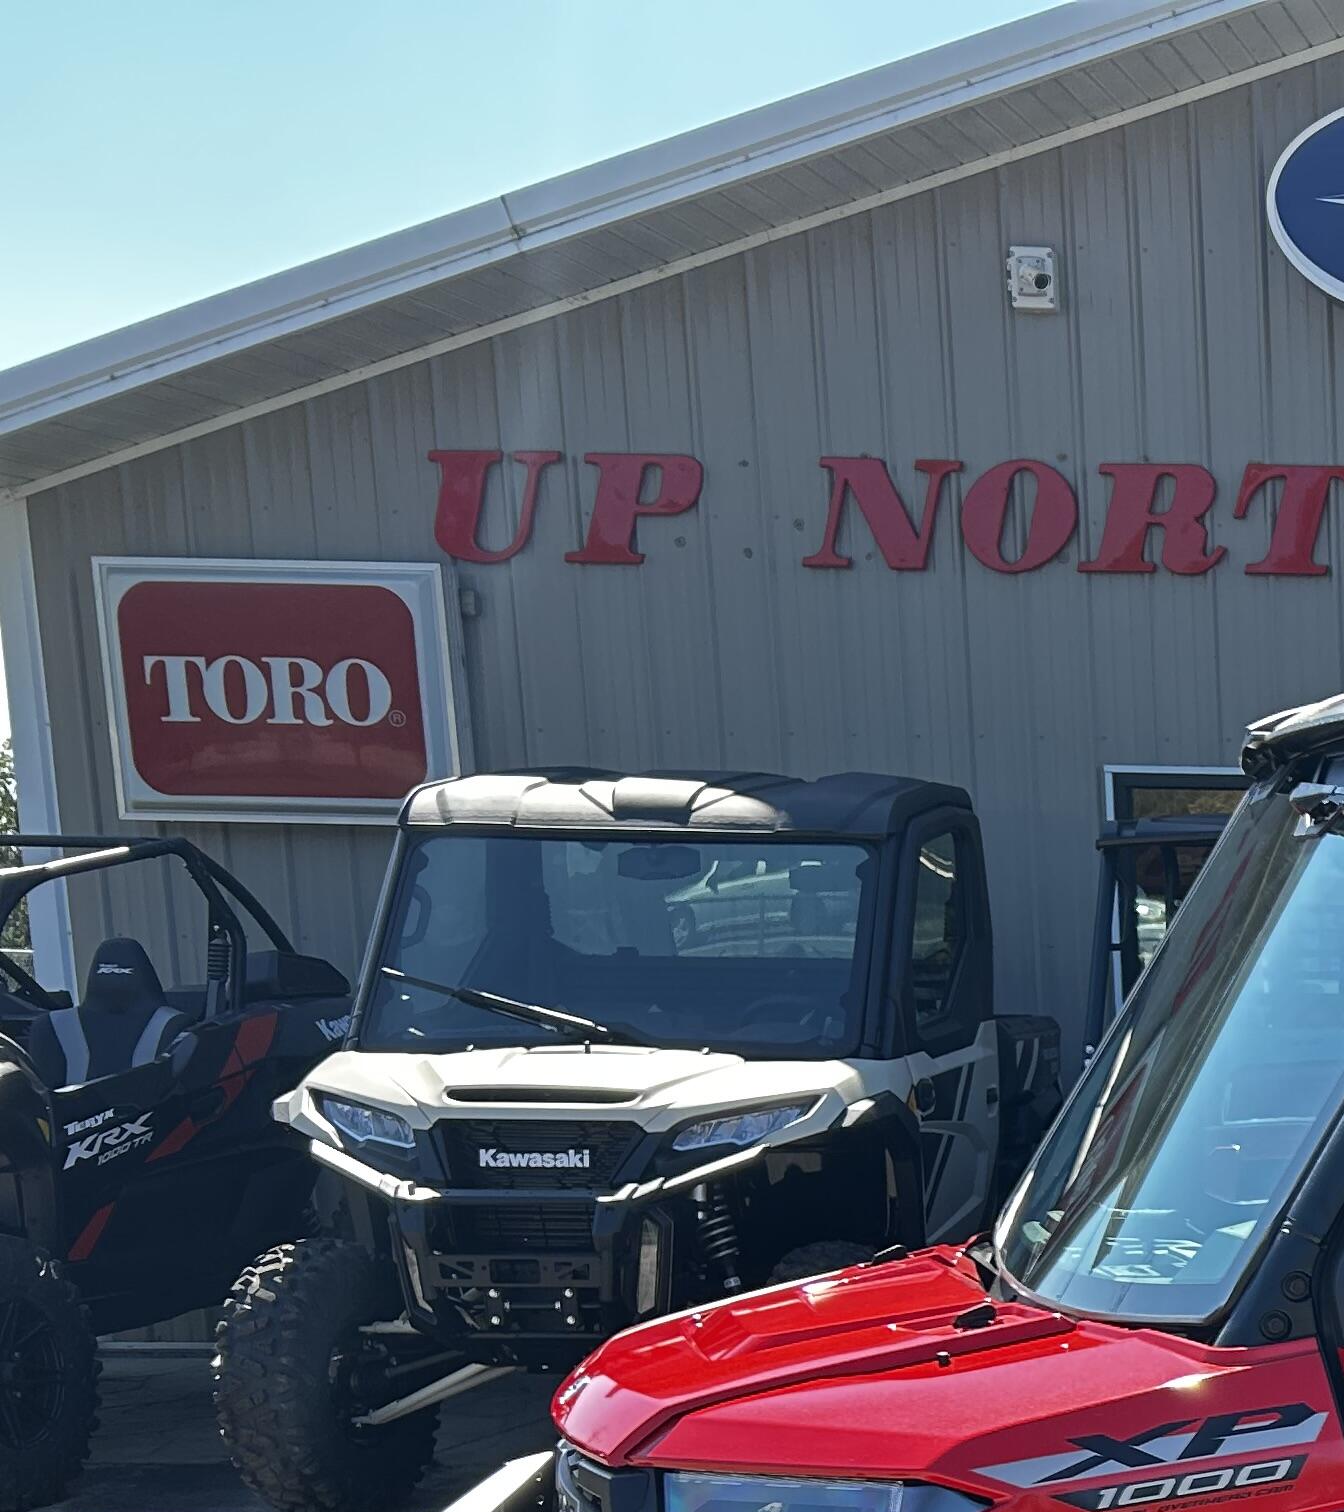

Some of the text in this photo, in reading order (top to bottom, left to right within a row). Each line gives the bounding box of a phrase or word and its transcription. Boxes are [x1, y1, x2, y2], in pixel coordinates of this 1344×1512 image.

[428, 449, 703, 565] UP
[143, 655, 392, 727] TORO
[63, 1111, 154, 1170] KRX
[479, 1148, 590, 1168] Kawasaki
[1032, 1401, 1317, 1485] XP
[1094, 1459, 1292, 1511] 1000
[1254, 1484, 1295, 1499] CAM
